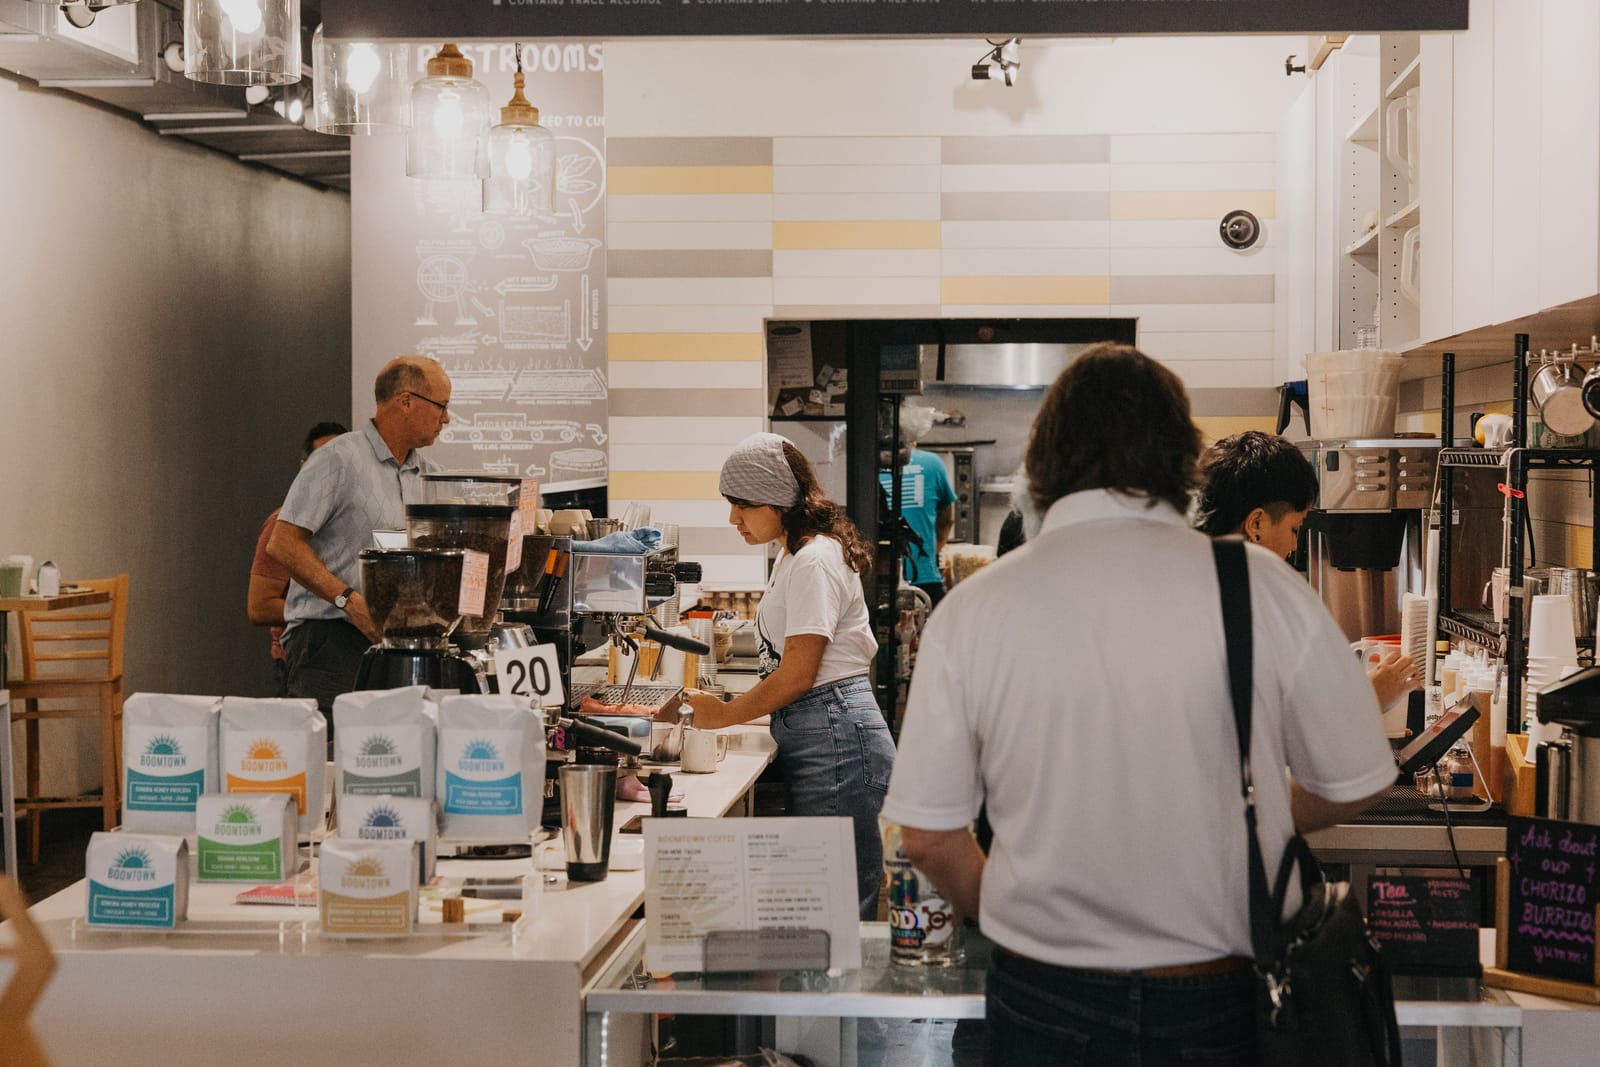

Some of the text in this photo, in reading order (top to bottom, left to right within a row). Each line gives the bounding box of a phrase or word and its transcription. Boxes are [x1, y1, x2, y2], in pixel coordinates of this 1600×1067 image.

[565, 115, 582, 128] TO
[507, 656, 551, 697] 20
[140, 754, 187, 768] BOOMTOWN
[241, 759, 288, 772] BOOMTOWN
[355, 754, 402, 768] BOOMTOWN
[458, 758, 505, 772] BOOMTOWN
[214, 823, 262, 836] BOOMTOWN
[358, 826, 407, 839] BOOMTOWN
[657, 835, 736, 843] BOOMTOWN COFFEE
[1521, 824, 1597, 856] Ask about
[1541, 858, 1571, 874] our
[107, 867, 156, 881] BOOMTOWN
[341, 875, 390, 889] BOOMTOWN
[1372, 881, 1409, 900] Tea
[1521, 877, 1586, 905] CHORIZO
[1523, 902, 1594, 930] BURRITO
